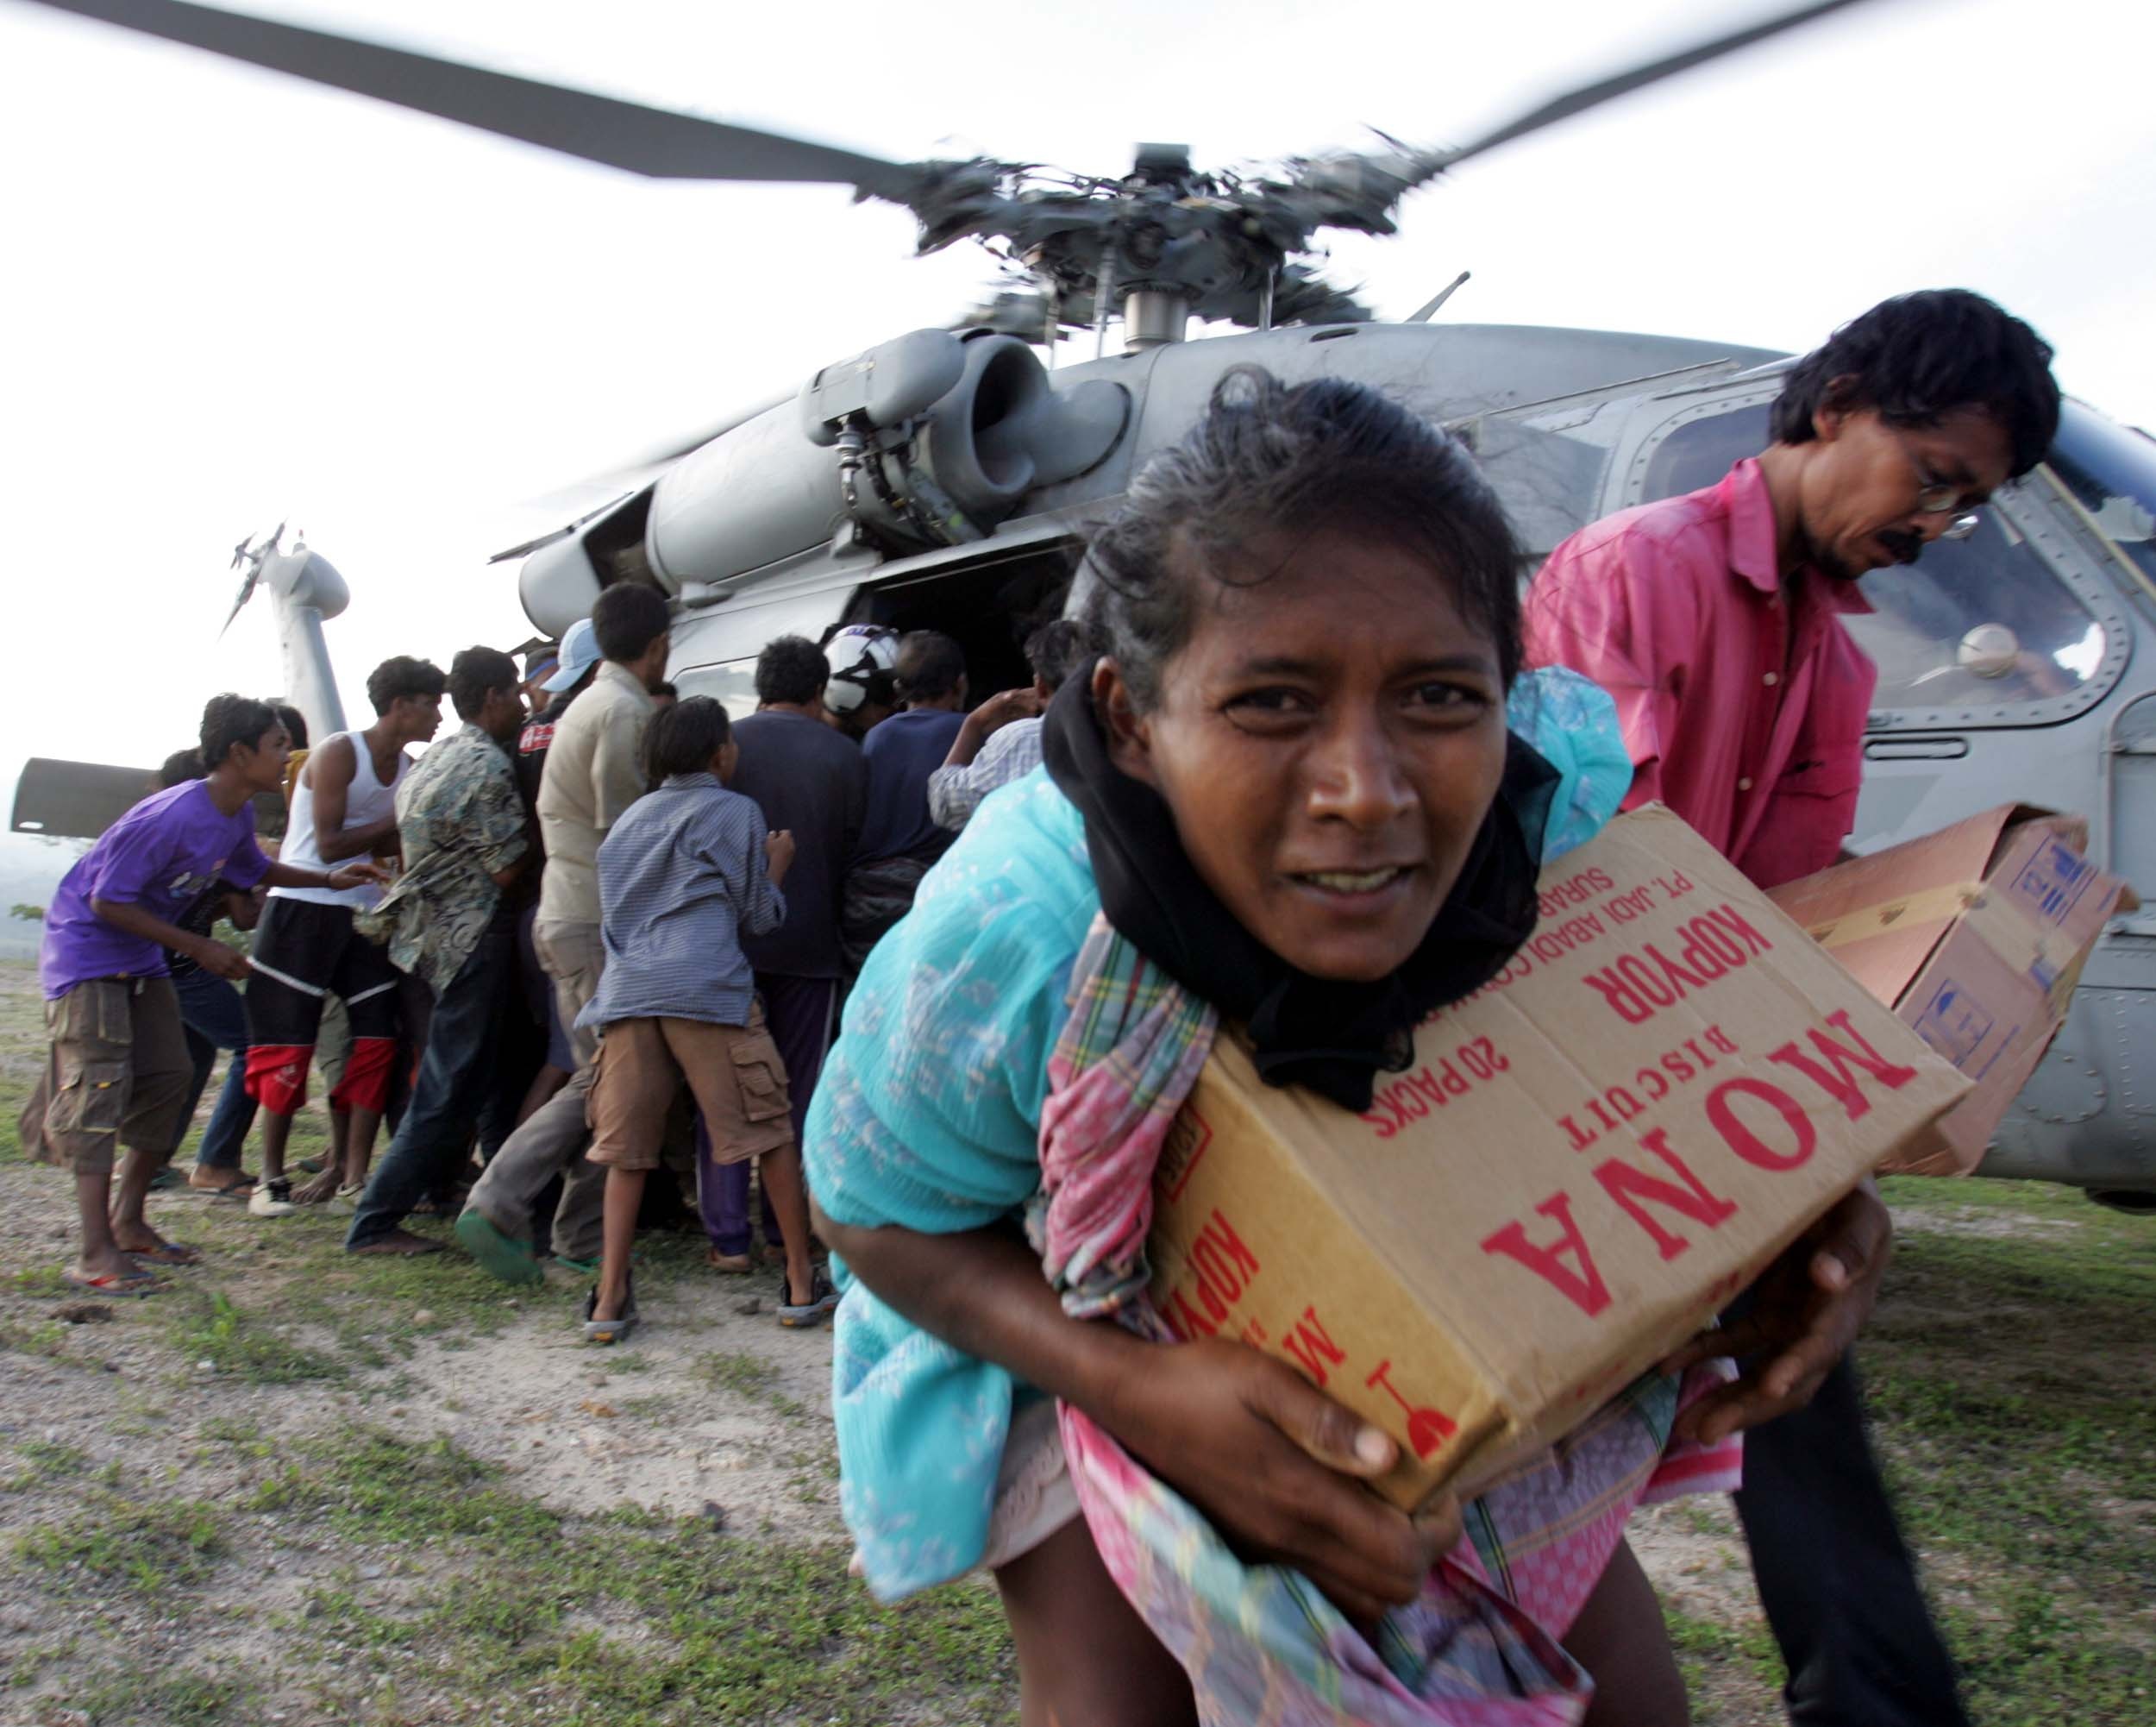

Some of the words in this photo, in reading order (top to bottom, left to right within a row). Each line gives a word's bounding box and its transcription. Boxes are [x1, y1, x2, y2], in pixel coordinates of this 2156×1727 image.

[1601, 887, 1656, 926] JADI
[1651, 869, 1694, 899] PT.
[1526, 911, 1607, 965] ABADI
[1583, 903, 1773, 1025] KOPYOR
[1358, 1058, 1471, 1140] PACKS
[1457, 1035, 1511, 1081] 20
[1557, 1025, 1739, 1152] BISCUIT
[1480, 1008, 1918, 1318] MONA
[1282, 1305, 1347, 1388] M
